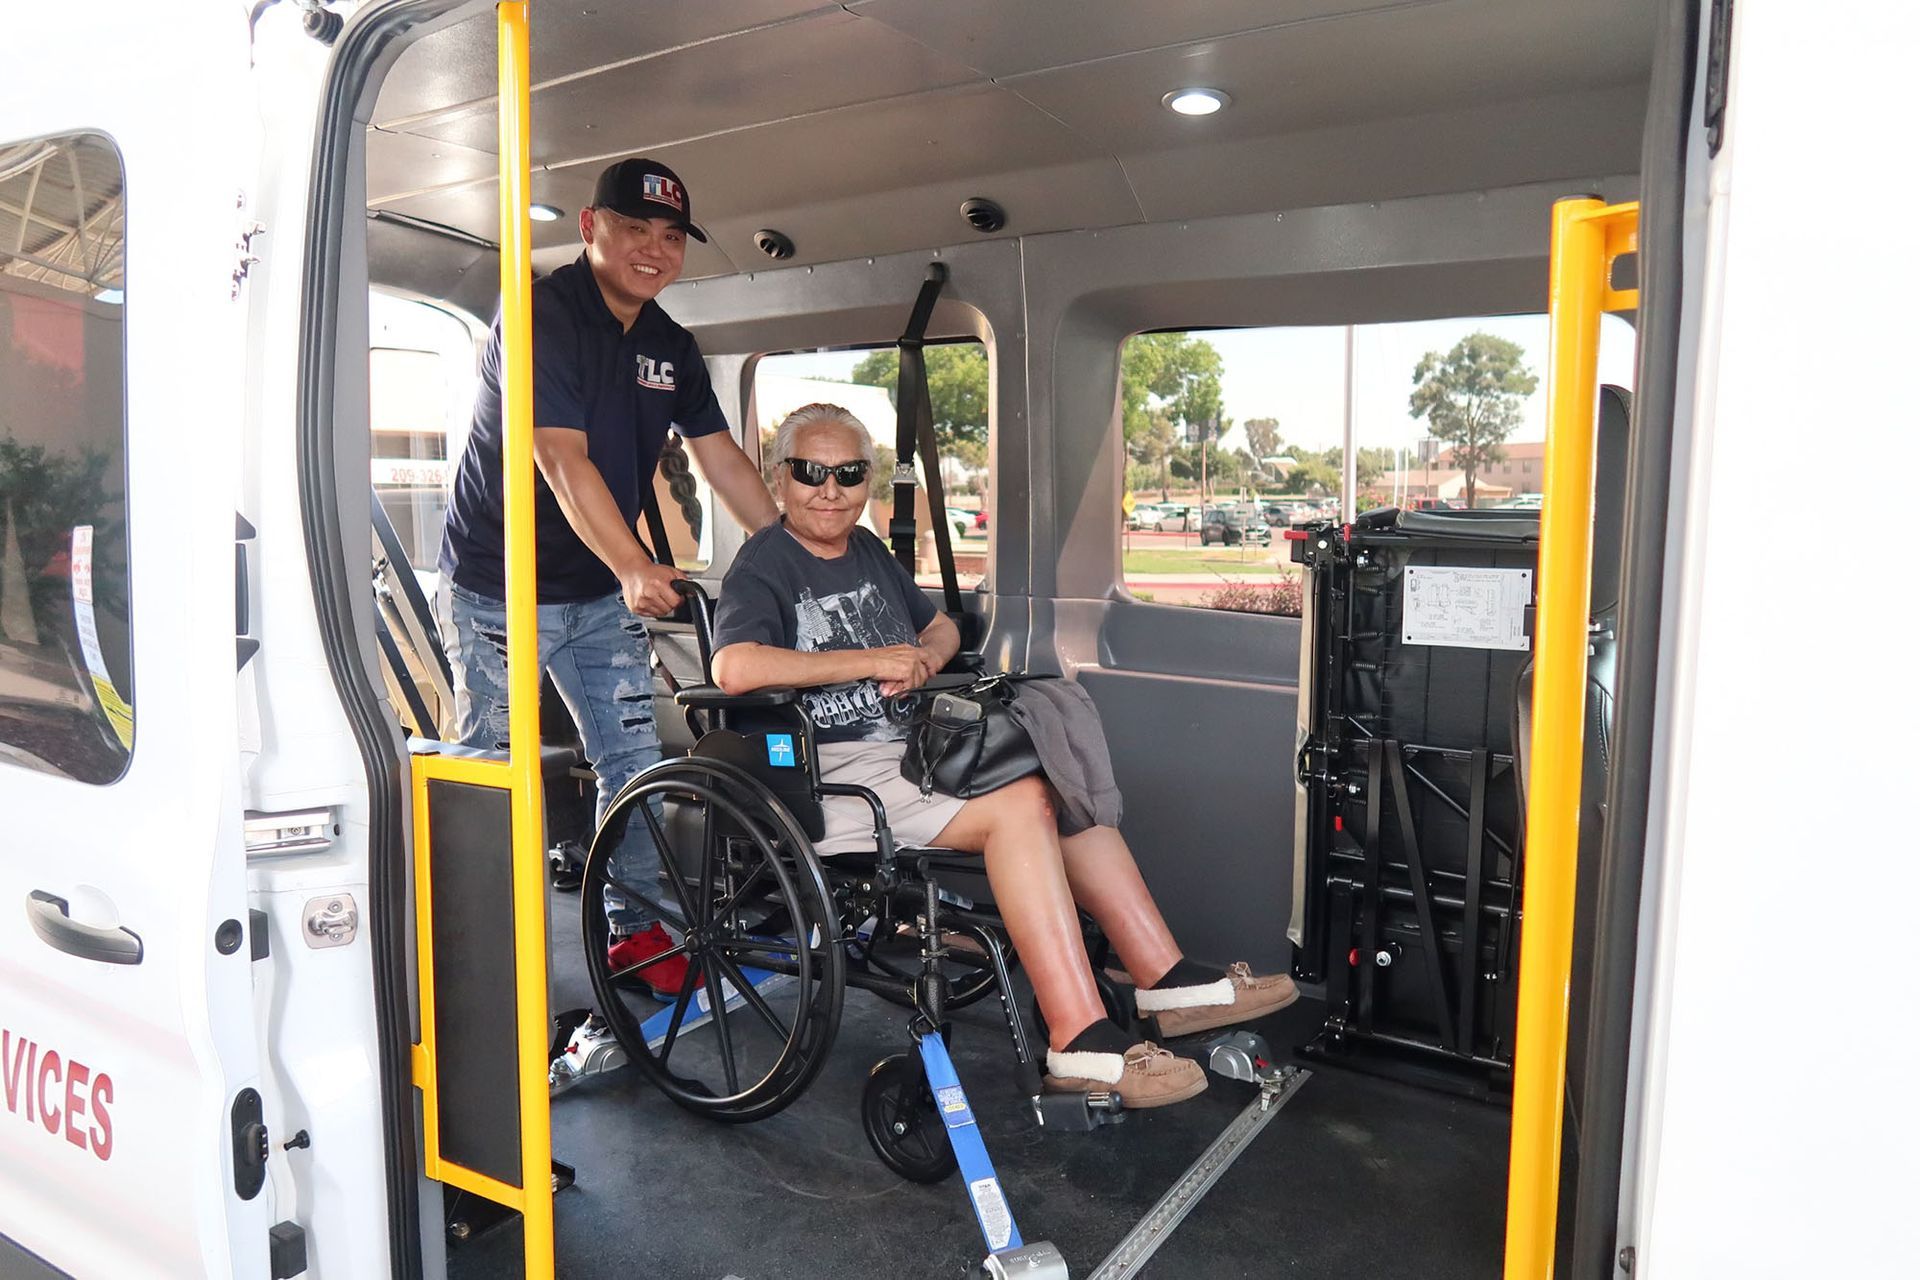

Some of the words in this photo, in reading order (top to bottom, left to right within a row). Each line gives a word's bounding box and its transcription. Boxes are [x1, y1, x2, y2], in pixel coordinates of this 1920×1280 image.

[644, 175, 681, 204] TLC
[636, 354, 674, 384] TLC
[2, 1028, 114, 1161] VICES
